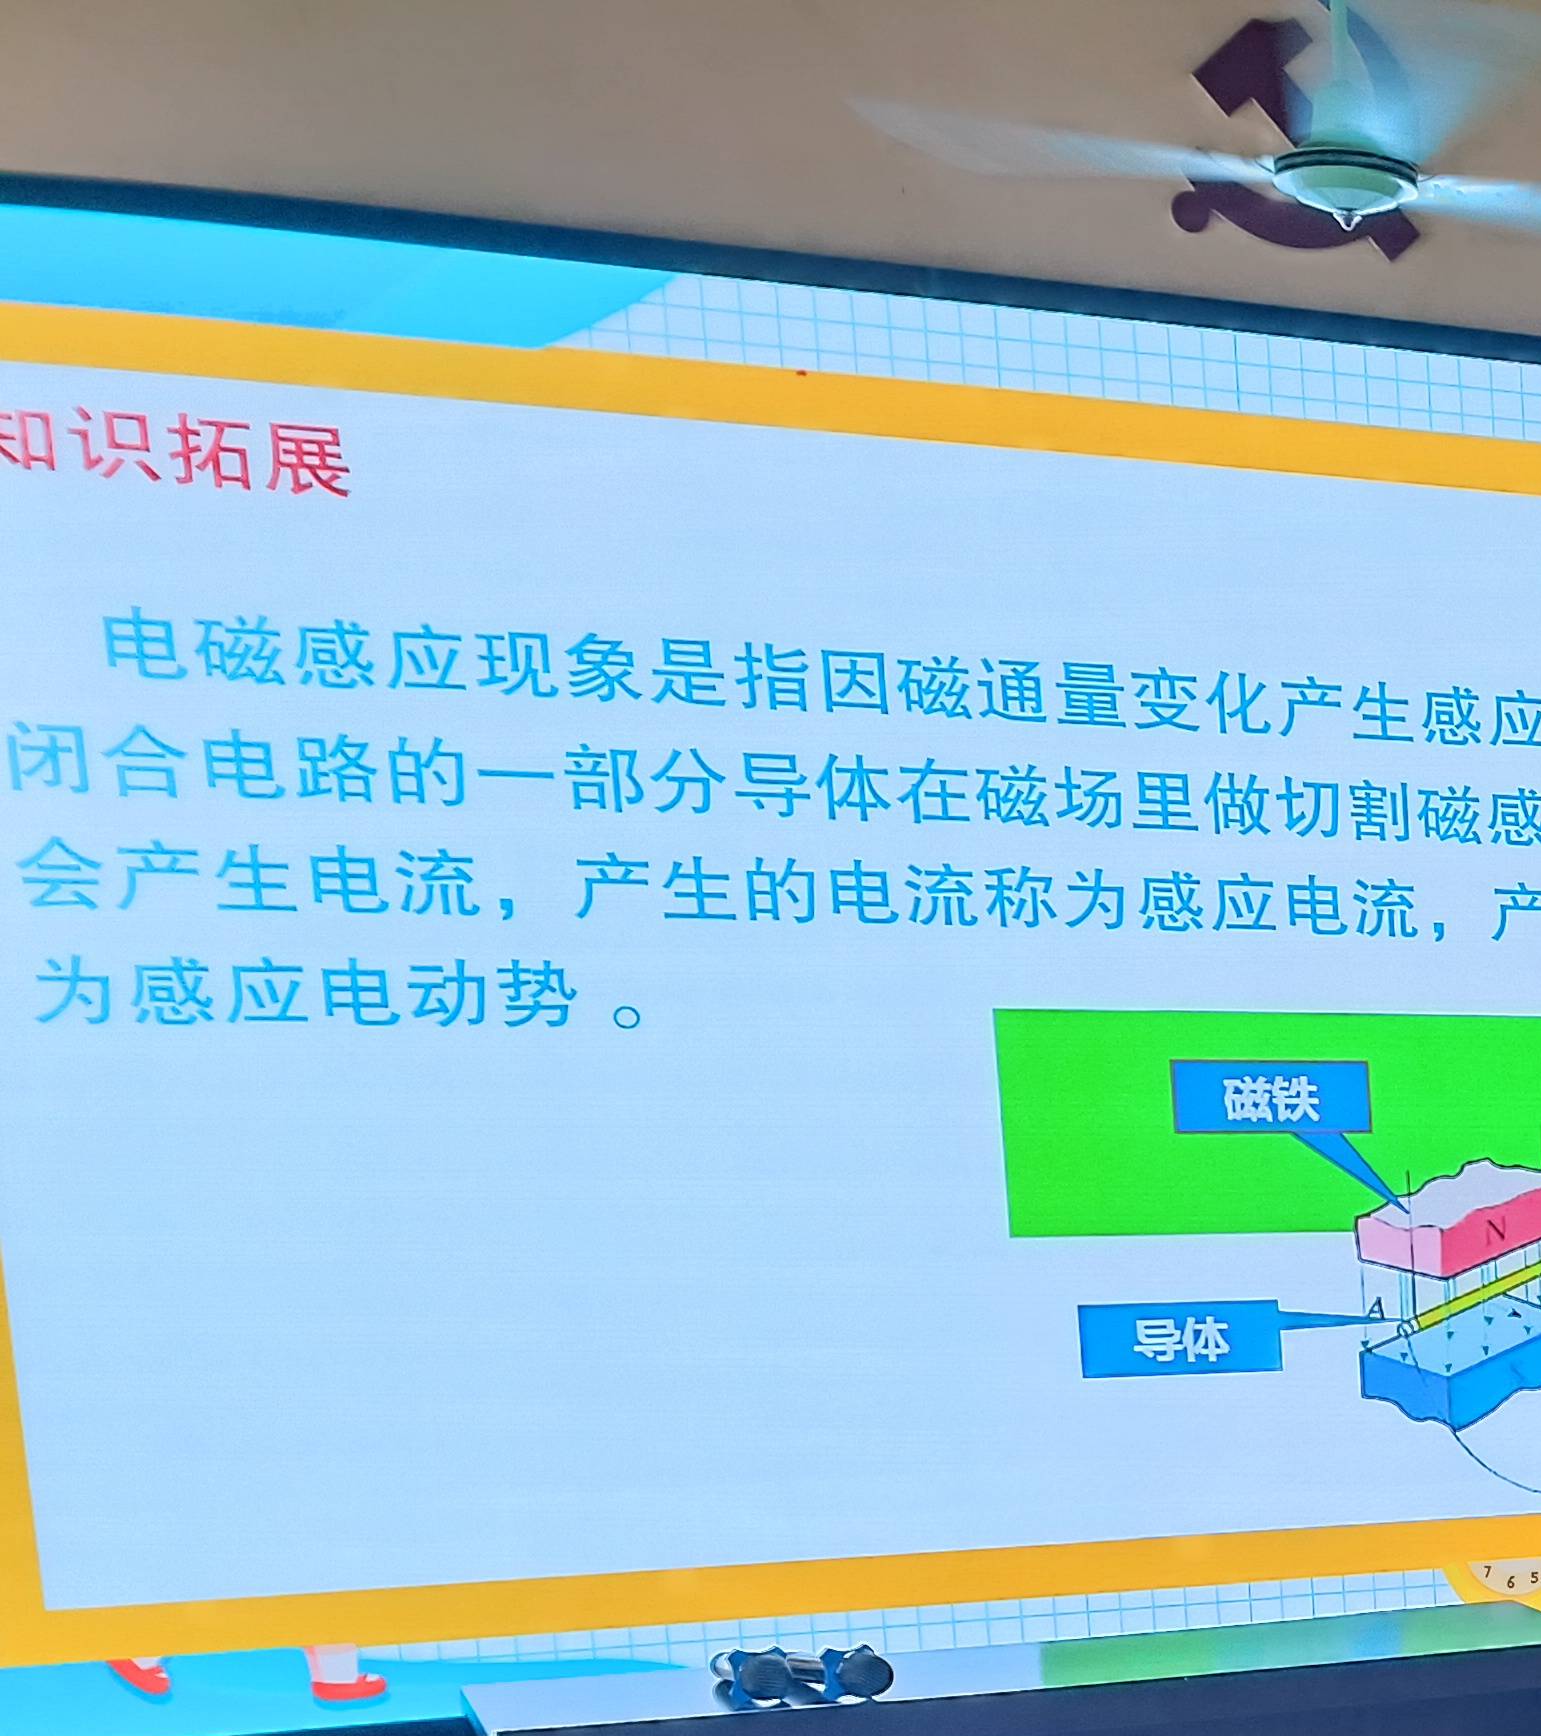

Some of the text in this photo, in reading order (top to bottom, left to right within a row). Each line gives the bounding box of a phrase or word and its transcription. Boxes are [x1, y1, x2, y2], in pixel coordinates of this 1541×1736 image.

[0, 406, 352, 498] 知识拓展
[1223, 1075, 1320, 1123] 磁铁
[1485, 1215, 1507, 1247] N
[1368, 1296, 1385, 1320] A
[1133, 1316, 1231, 1363] 导体
[1484, 1565, 1492, 1578] 7
[1507, 1576, 1515, 1589] 6
[1530, 1571, 1539, 1584] 5
